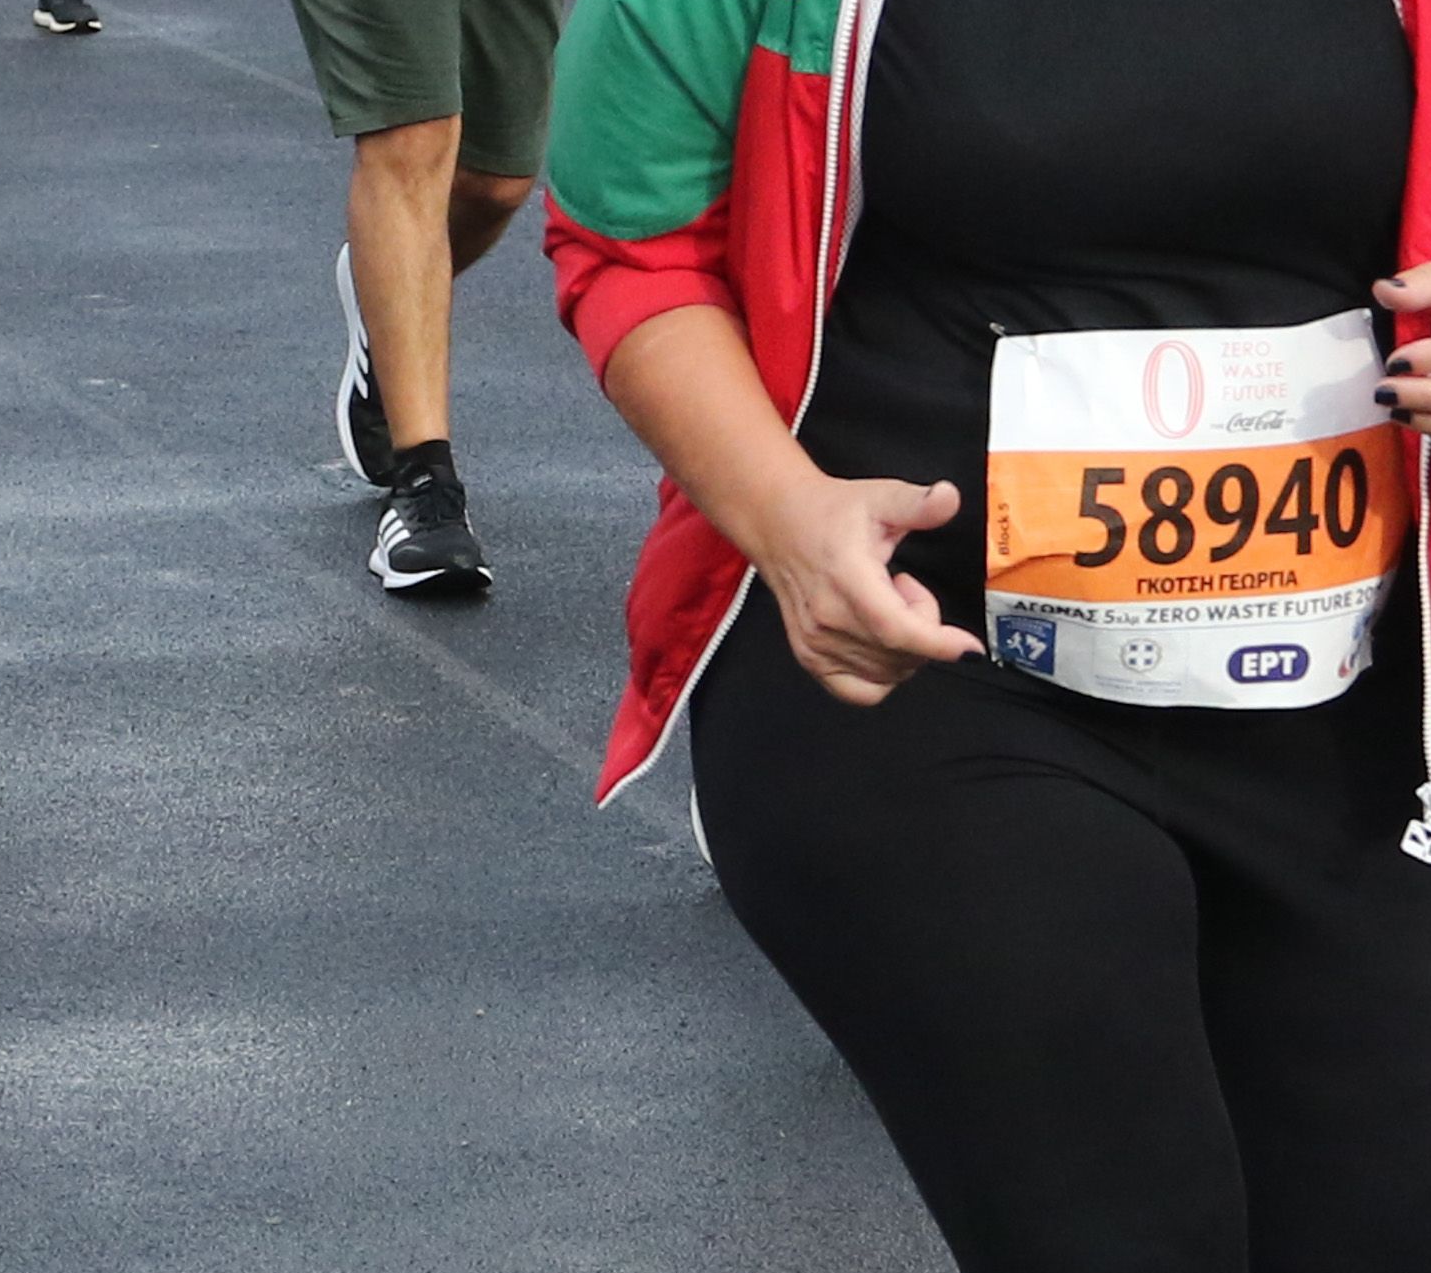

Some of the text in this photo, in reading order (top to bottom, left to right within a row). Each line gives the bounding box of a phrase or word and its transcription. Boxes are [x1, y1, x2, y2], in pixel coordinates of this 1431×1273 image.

[1221, 341, 1271, 358] ZERO
[1221, 362, 1285, 378] WASTE
[1221, 383, 1289, 402] FUTURE
[1073, 448, 1369, 568] 58940
[998, 516, 1011, 556] Block
[1137, 570, 1299, 595] ΓΚΟΤΣΗ ΓΕΩΡΓΙΑ
[1014, 601, 1098, 624] ΑΓΩΝΑΣ
[1145, 607, 1201, 624] ZERO
[1207, 601, 1278, 621] WASTE
[1284, 593, 1353, 616] FUTURE
[1241, 650, 1298, 678] ΕΡΤ
